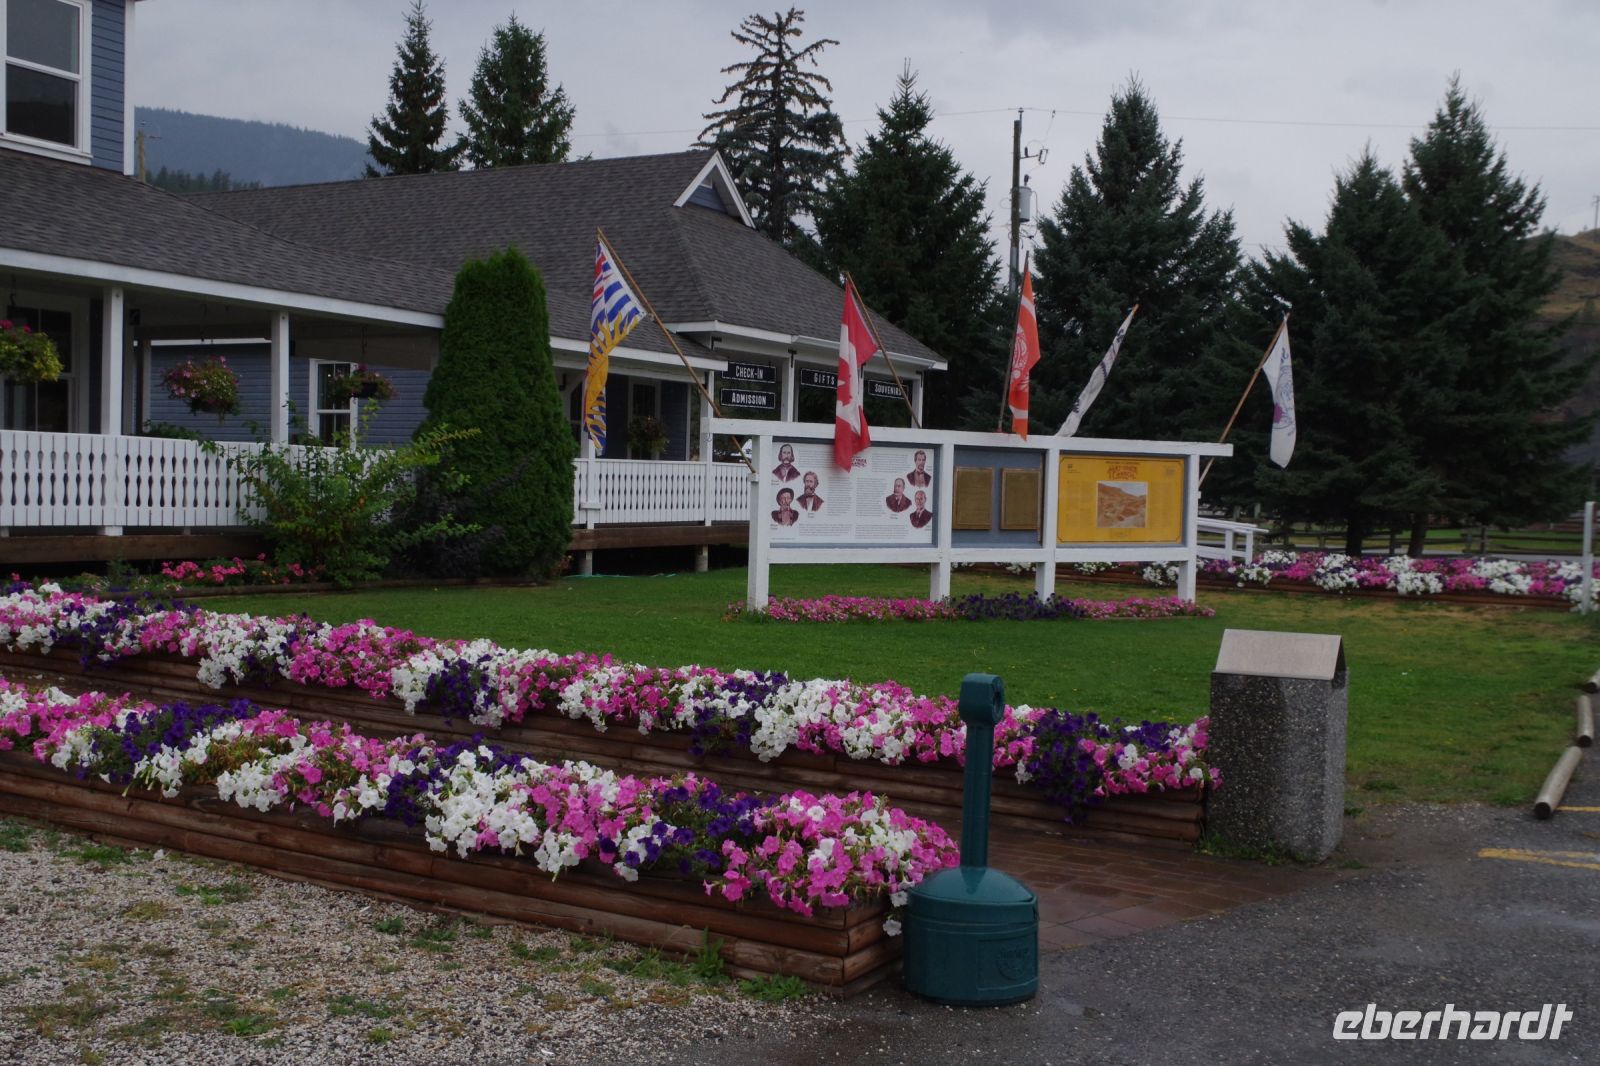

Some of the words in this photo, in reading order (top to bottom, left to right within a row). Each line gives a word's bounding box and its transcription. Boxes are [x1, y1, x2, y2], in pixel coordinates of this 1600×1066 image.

[735, 365, 764, 379] CHECK-IN
[814, 373, 835, 385] GIFTS
[731, 392, 767, 405] ADMISSION
